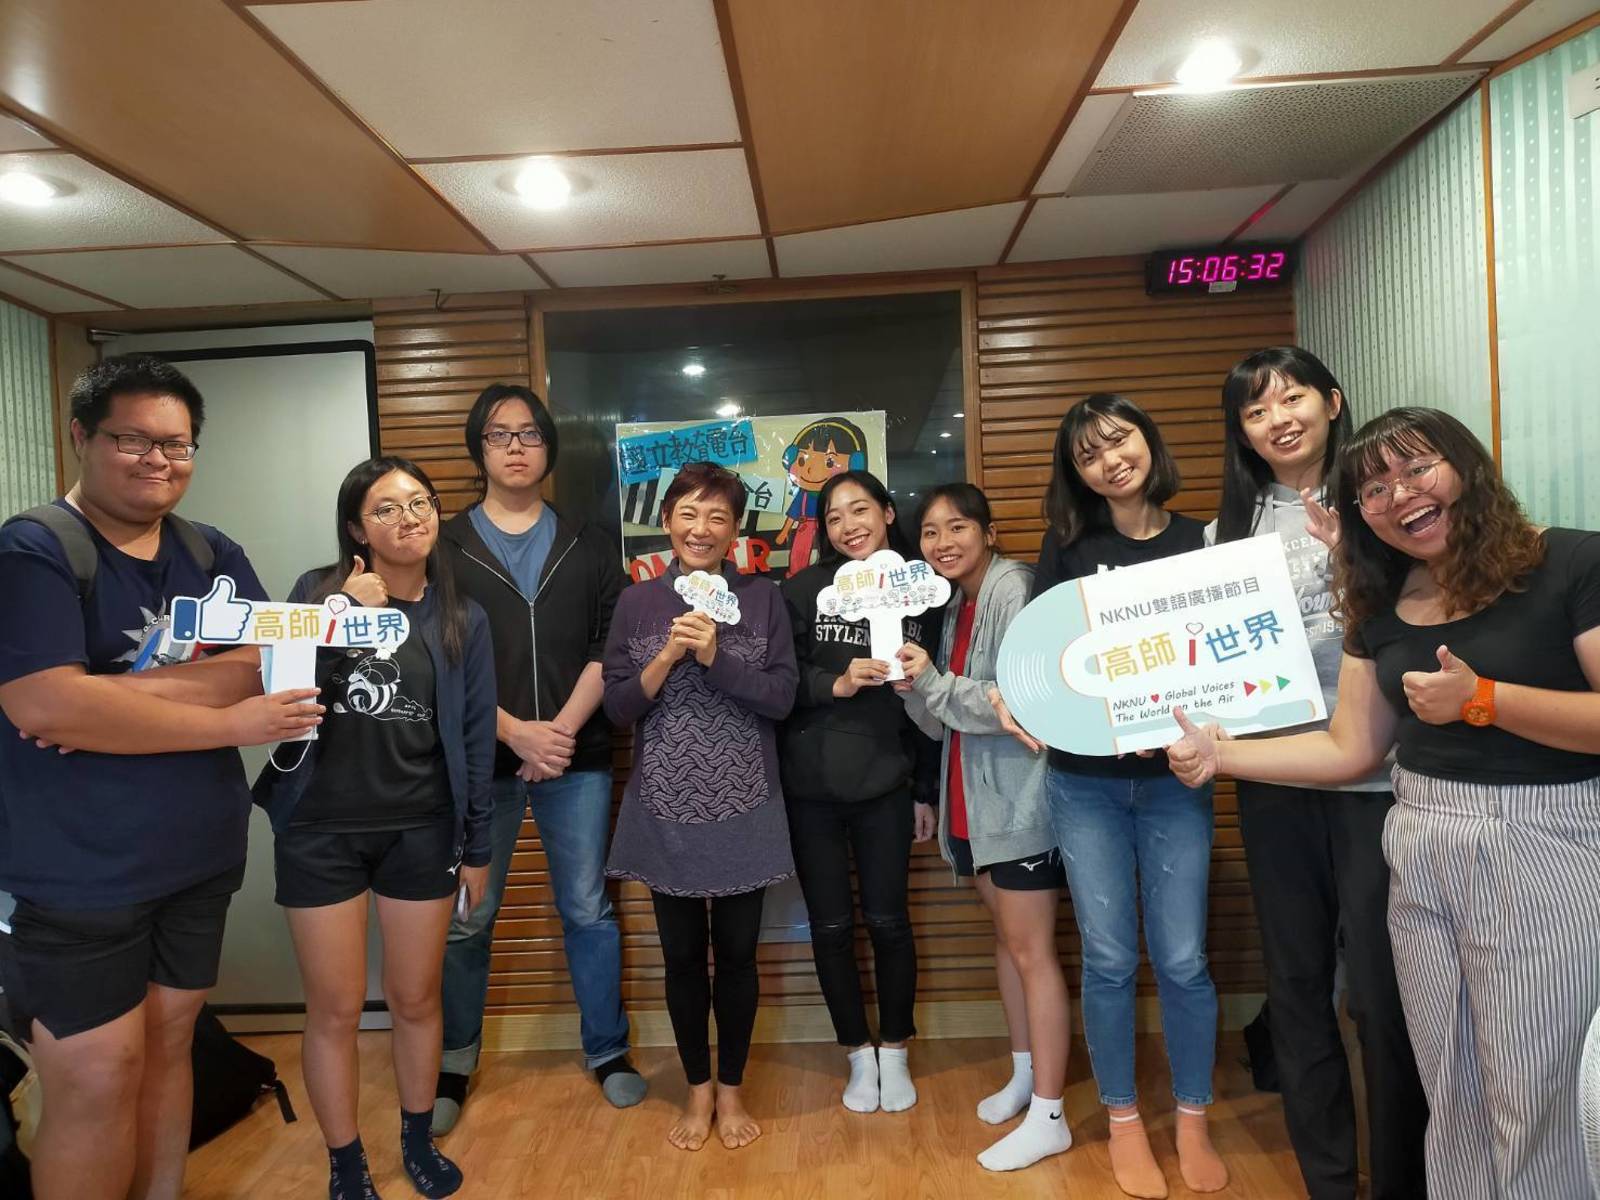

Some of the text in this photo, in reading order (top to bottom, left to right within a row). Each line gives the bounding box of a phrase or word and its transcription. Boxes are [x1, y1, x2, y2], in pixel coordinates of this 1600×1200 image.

[1168, 252, 1285, 285] 15:06:32
[1100, 576, 1261, 626] NKNU雙語廣播節目
[1112, 681, 1235, 711] NKNU Global Voices
[1116, 712, 1135, 723] The
[1140, 704, 1171, 720] World
[1194, 698, 1213, 709] the
[1218, 693, 1235, 705] Air
